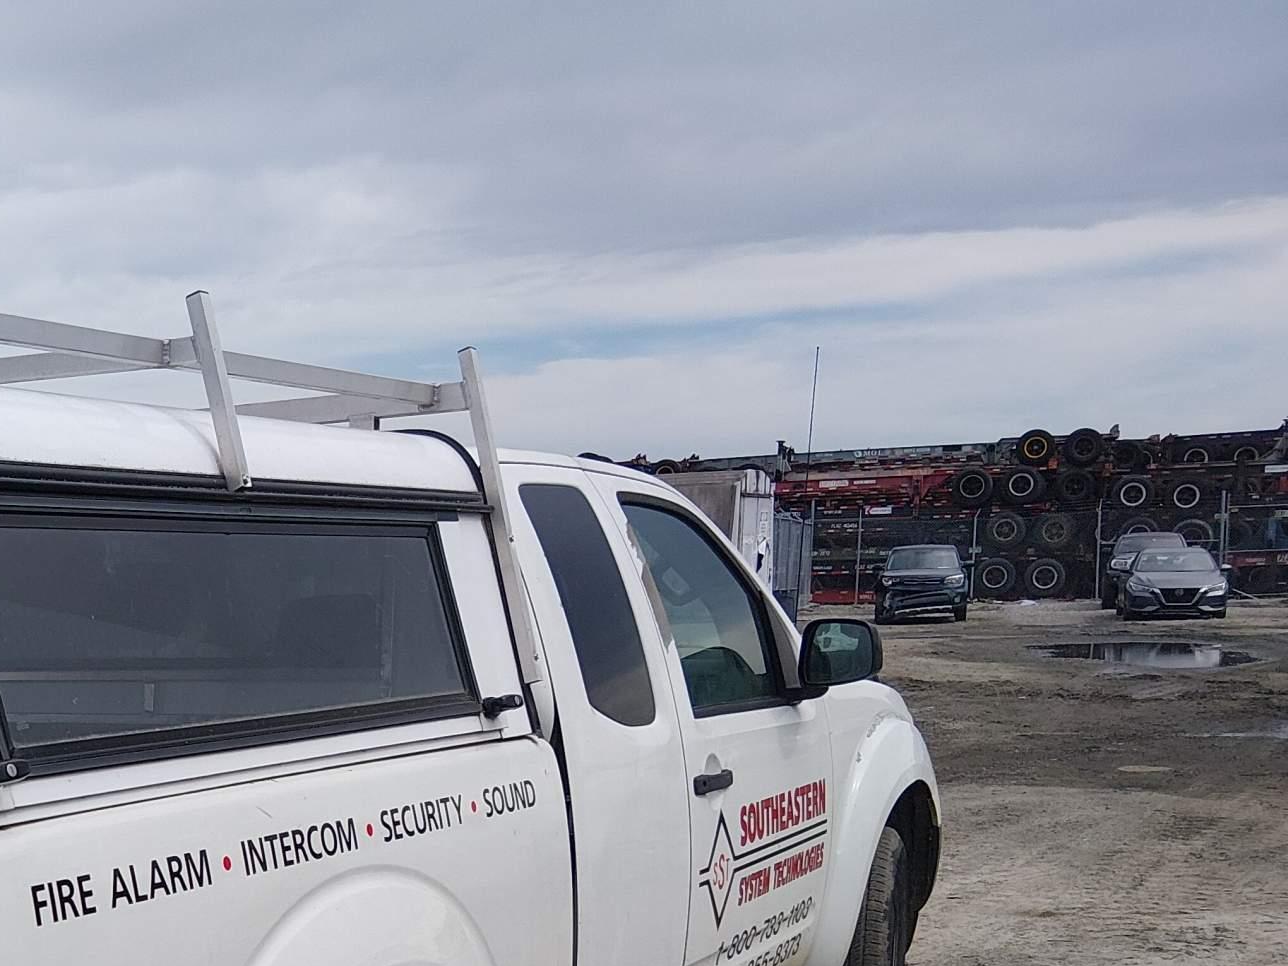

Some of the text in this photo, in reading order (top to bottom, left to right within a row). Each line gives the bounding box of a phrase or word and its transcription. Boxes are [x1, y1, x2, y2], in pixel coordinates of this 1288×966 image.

[740, 779, 826, 847] SOUTHEASTERN
[30, 779, 537, 927] FIRE ALARM INTERCOM SECURITY SOUND
[713, 853, 730, 890] SST
[738, 842, 825, 906] SYSTEM TECHNOLOGIES
[716, 896, 813, 966] 1-800-733-1103
